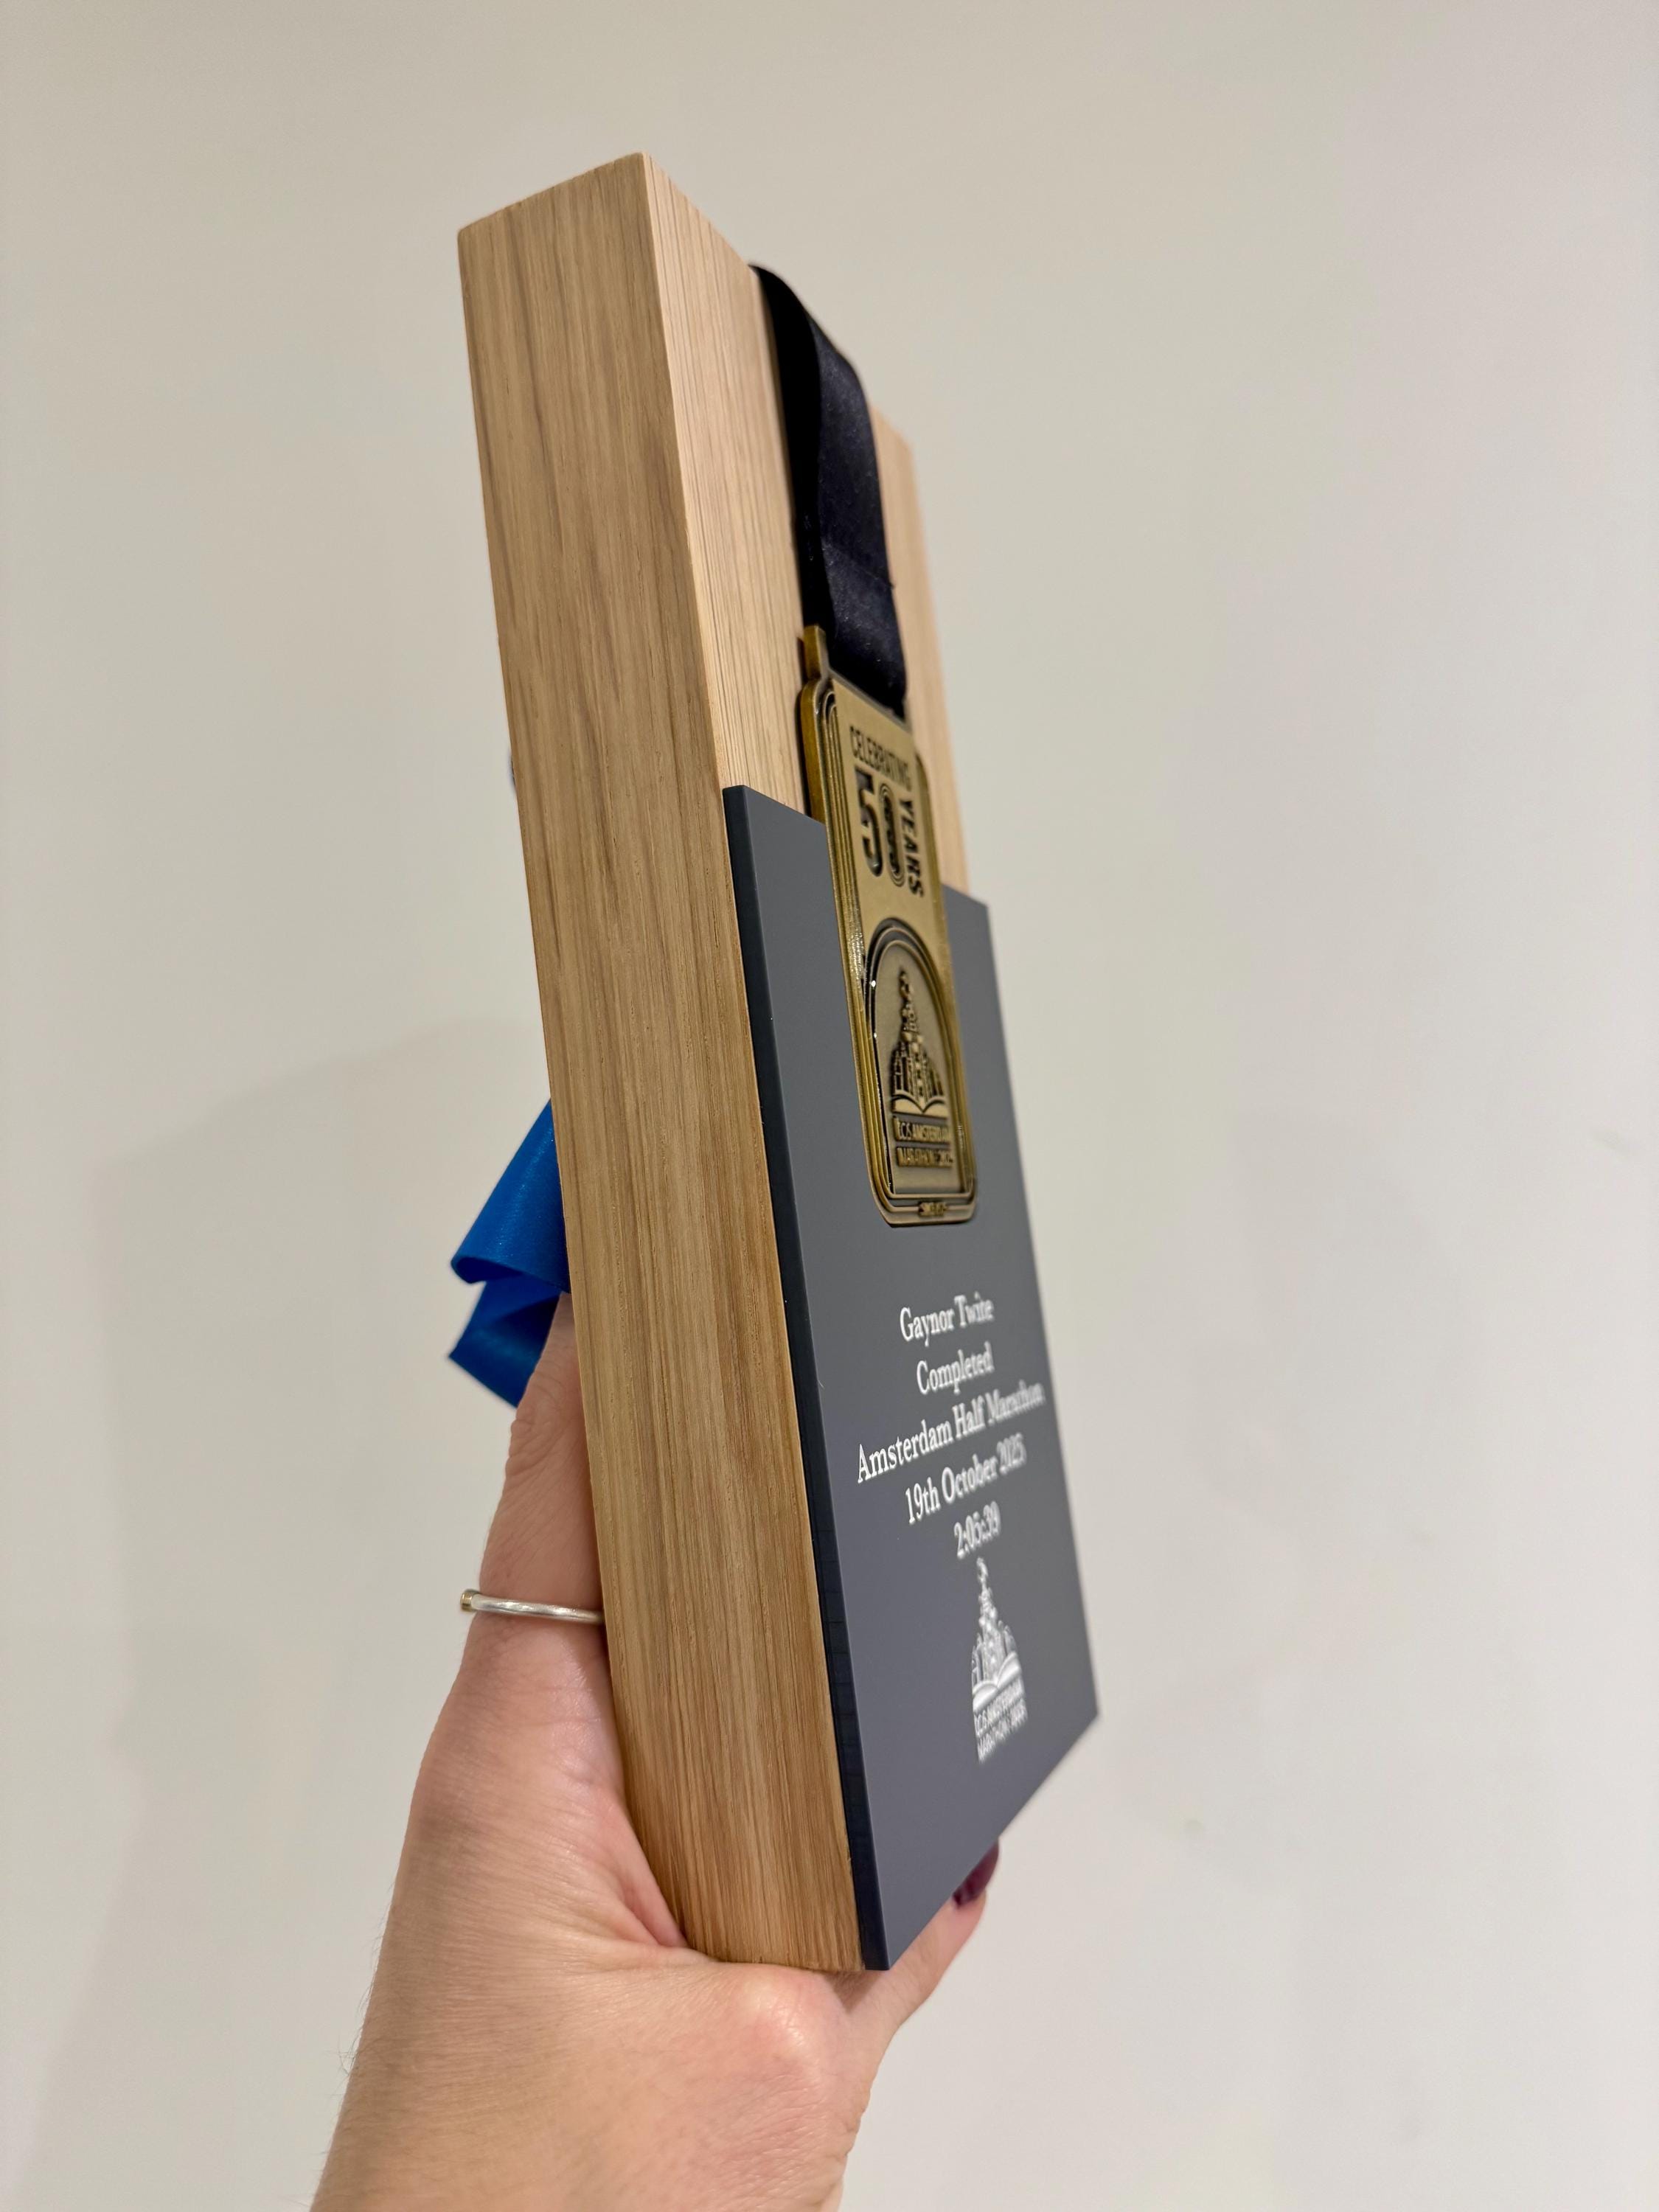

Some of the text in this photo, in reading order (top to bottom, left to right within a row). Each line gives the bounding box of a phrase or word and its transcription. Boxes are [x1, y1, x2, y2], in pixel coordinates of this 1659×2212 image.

[855, 765, 905, 888] 50
[899, 798, 925, 897] YEARS
[900, 1306, 956, 1348] Gaynor
[916, 1340, 995, 1396] Completed
[857, 1379, 1046, 1484] Amsterdam Half Marathon
[905, 1476, 942, 1526] 19th
[940, 1453, 998, 1505] October
